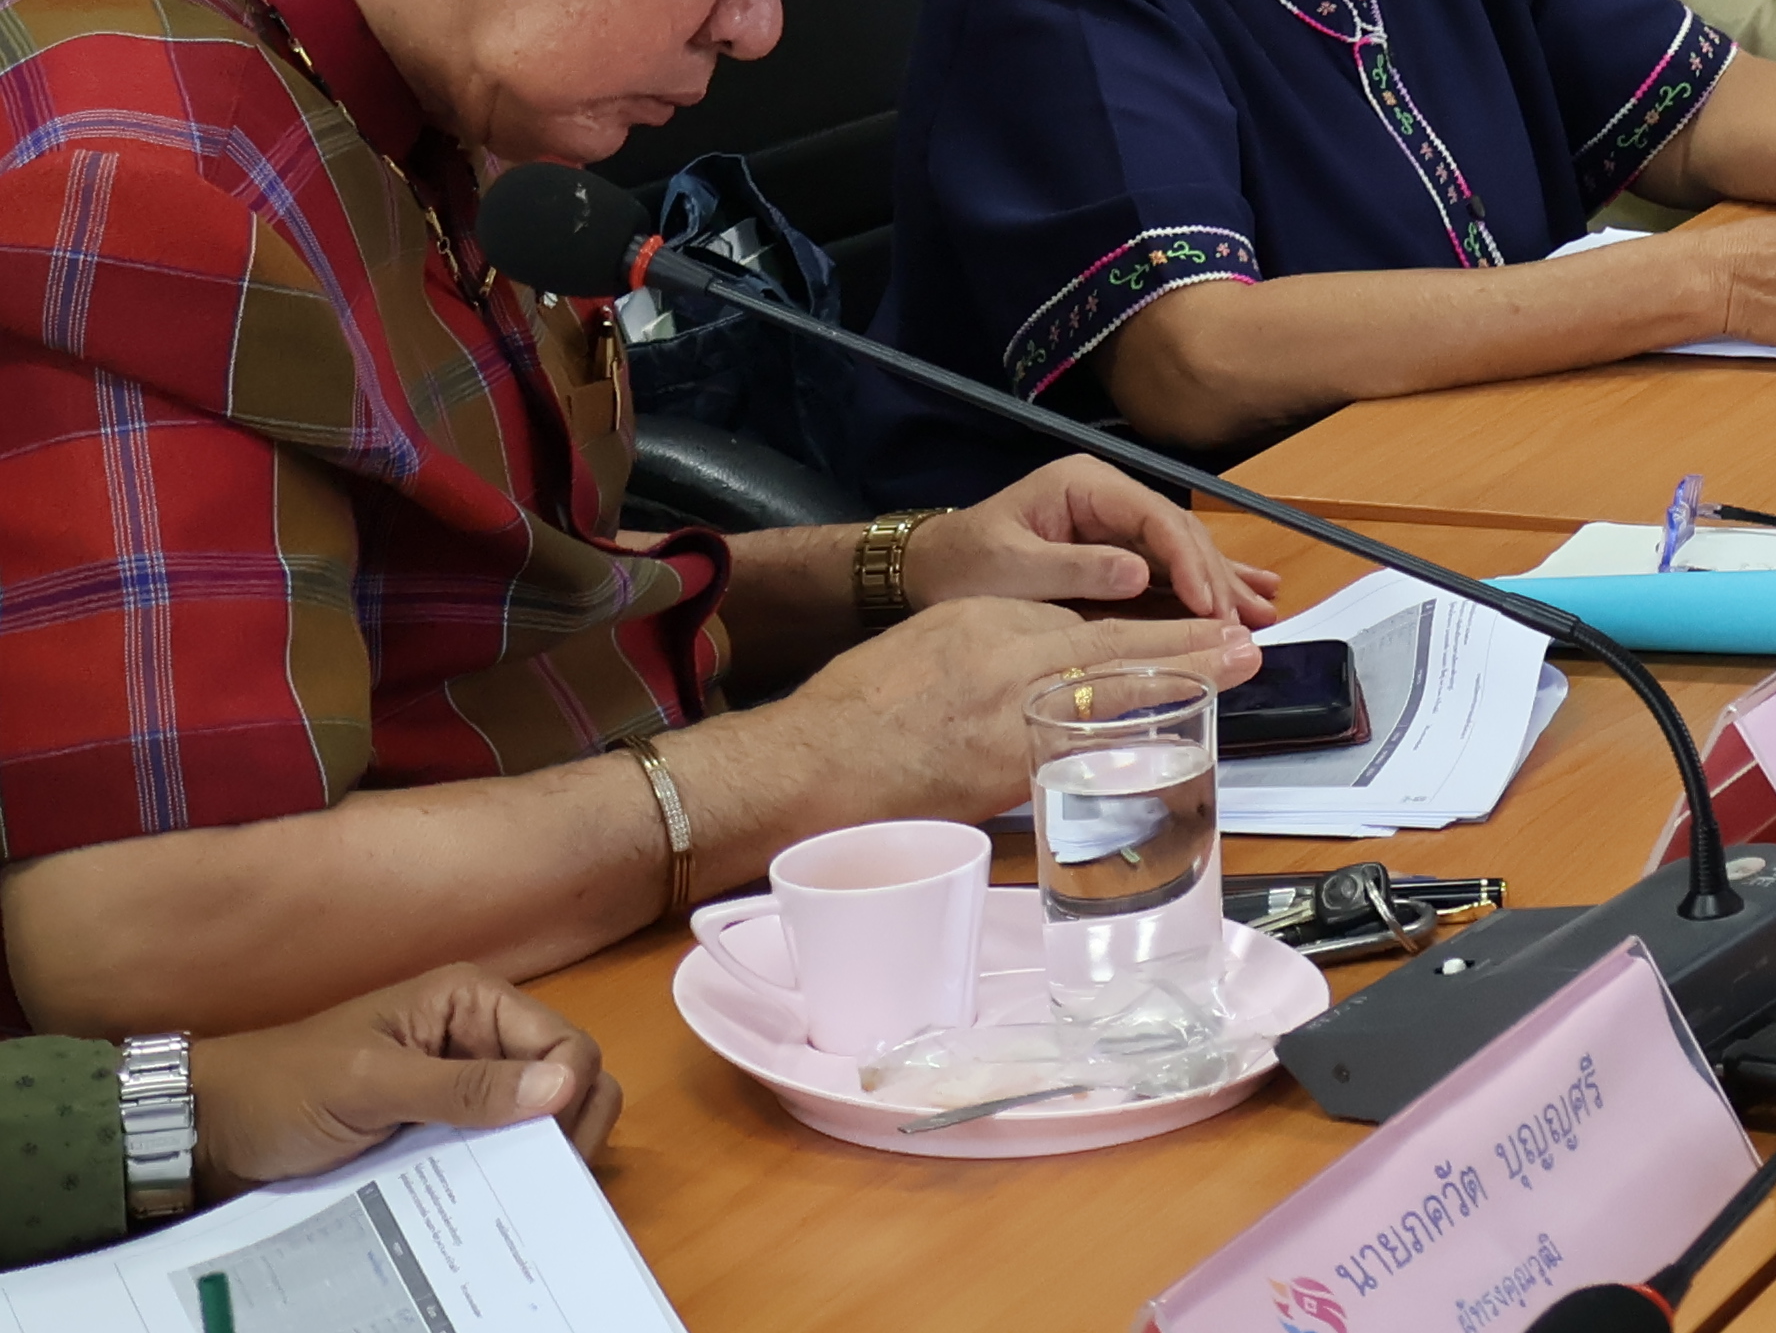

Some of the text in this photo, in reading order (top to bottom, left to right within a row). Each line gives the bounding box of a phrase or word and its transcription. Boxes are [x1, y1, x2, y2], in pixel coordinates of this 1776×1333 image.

[1335, 1054, 1606, 1297] นายภควัต บุญญศรี
[1455, 1232, 1564, 1333] ผ้ทรงคุณวุฒิ
